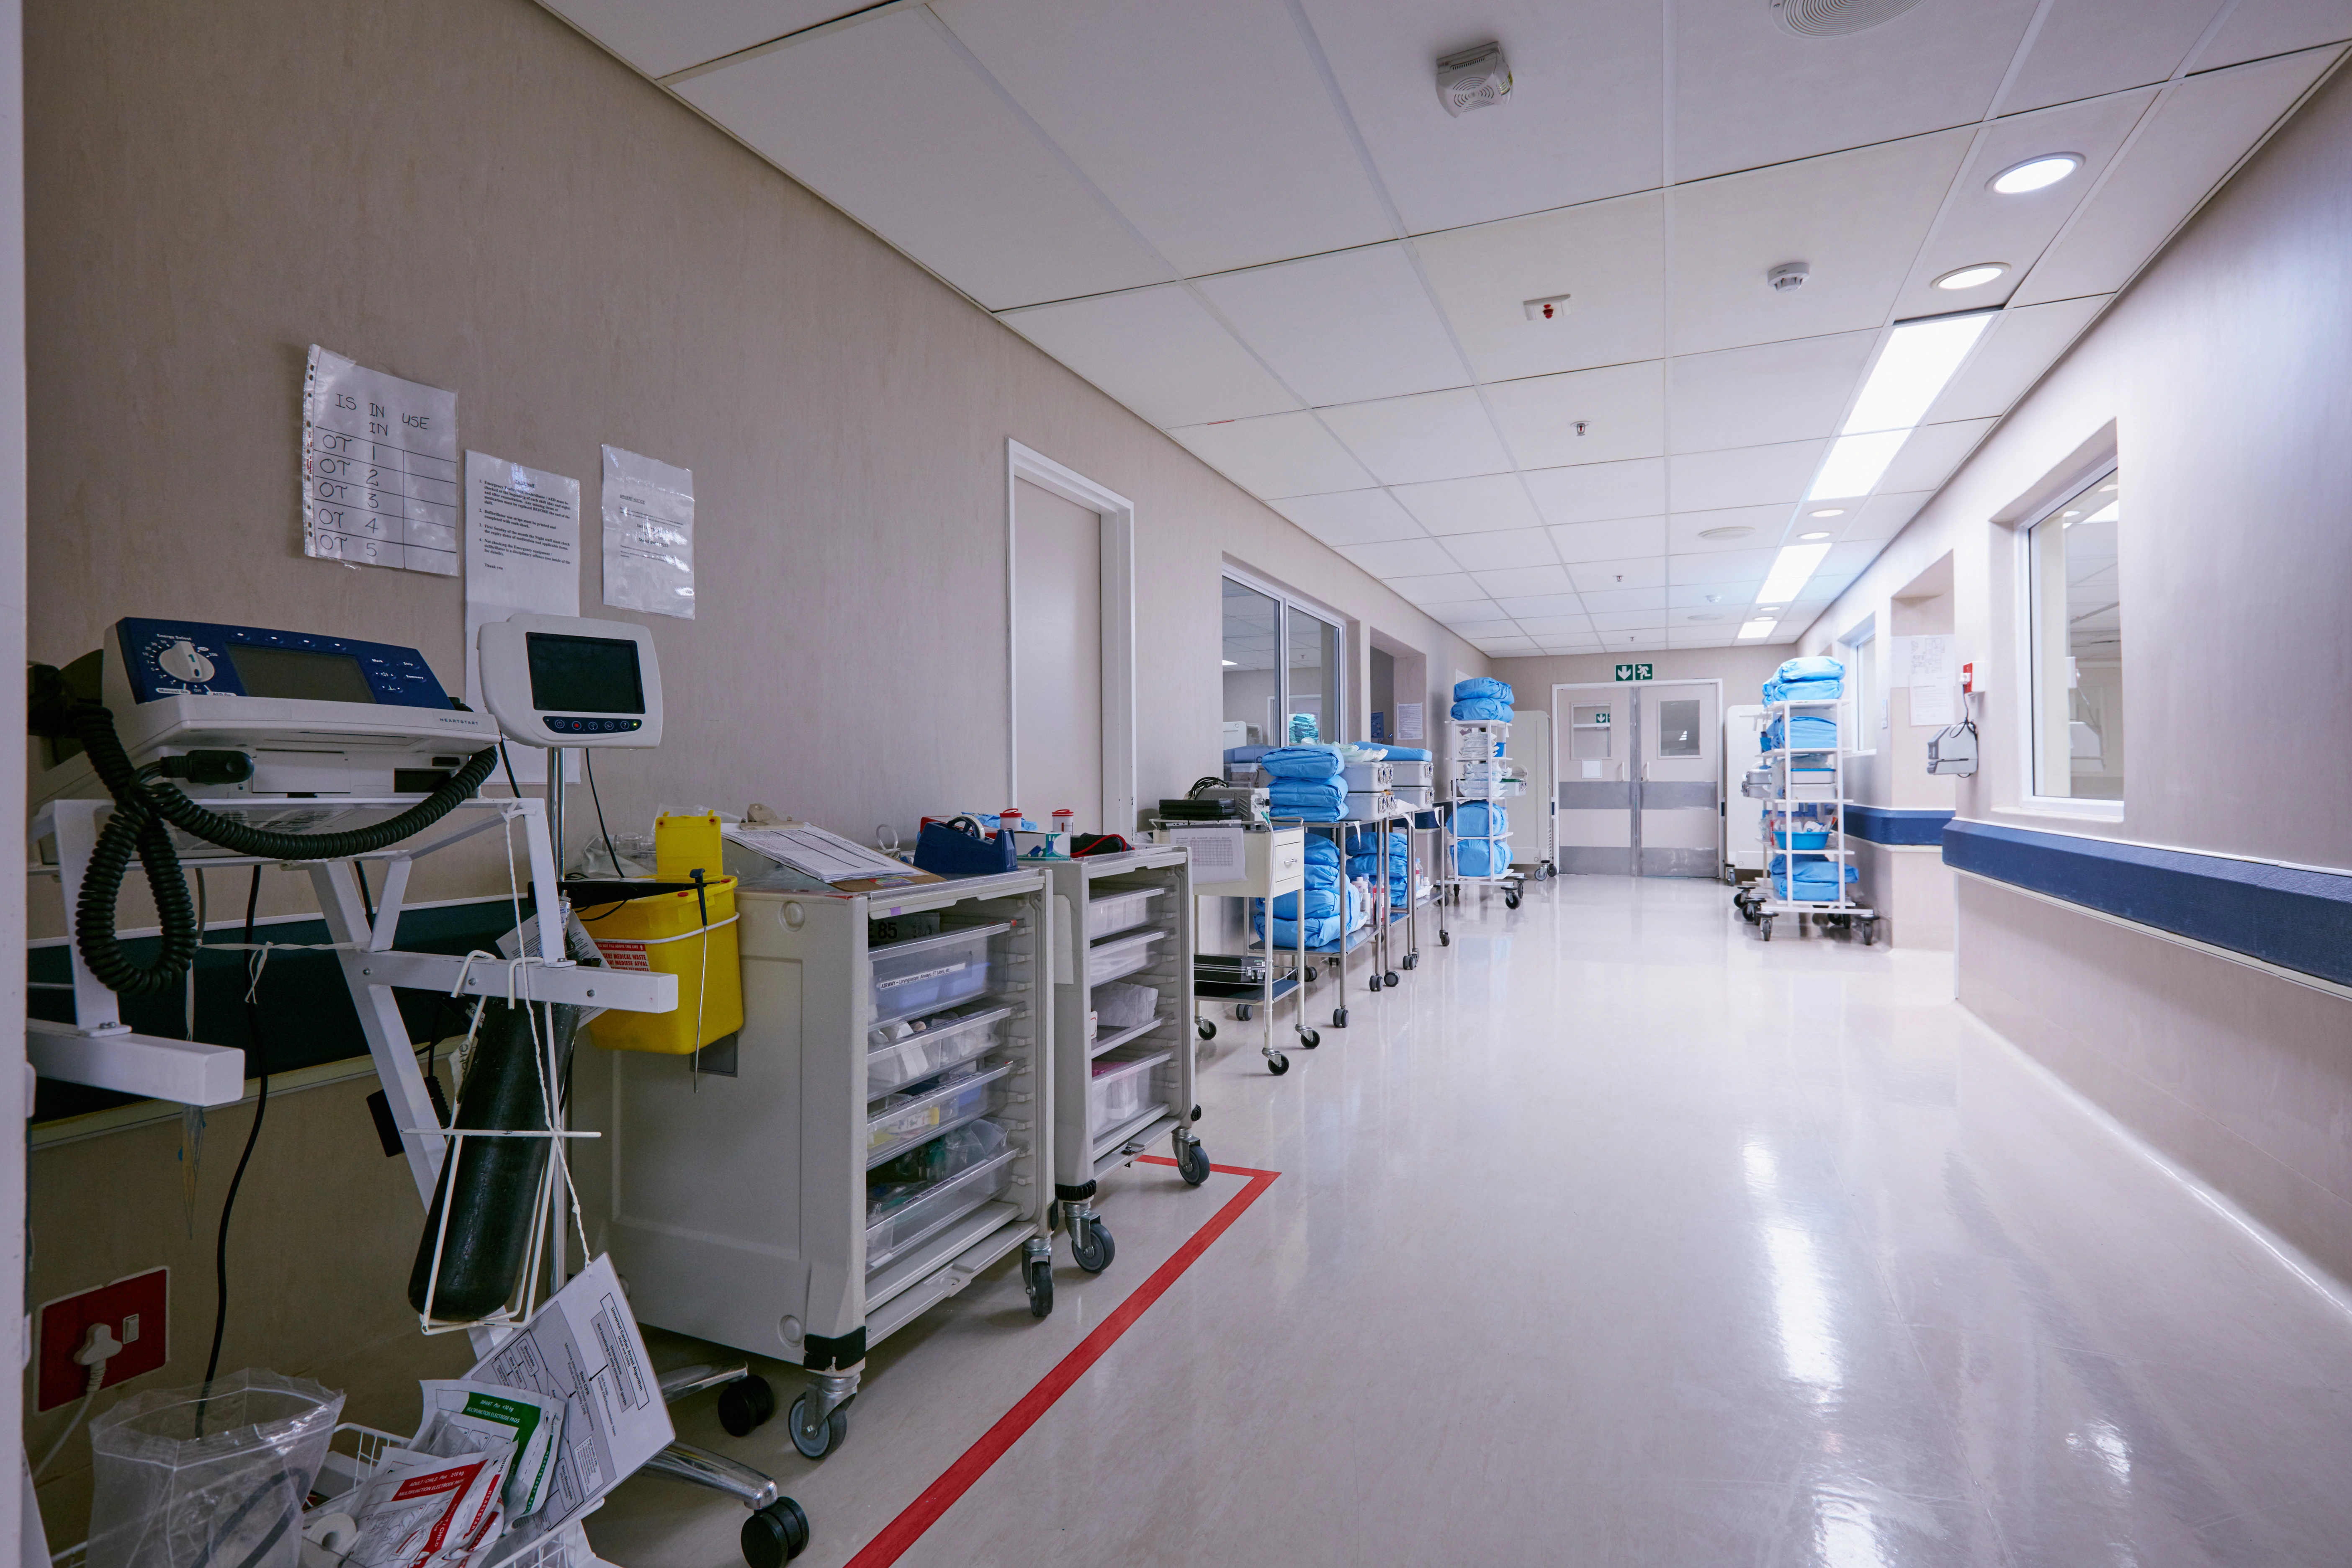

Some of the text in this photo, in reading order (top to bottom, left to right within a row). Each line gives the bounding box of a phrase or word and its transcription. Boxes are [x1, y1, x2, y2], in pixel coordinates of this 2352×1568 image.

[335, 394, 430, 430] IS IN USE
[369, 422, 388, 436] IN
[323, 434, 375, 460] OT 1
[320, 458, 350, 476] OT
[366, 469, 379, 487] 2
[319, 482, 379, 508] OT 3
[484, 480, 503, 489] Emergency
[525, 491, 545, 499] Defibrillator
[501, 495, 523, 503] resuscitation.
[509, 492, 526, 500] beginning
[319, 508, 378, 534] OT 4
[484, 510, 506, 518] Defibrillator
[320, 534, 377, 557] OT 5
[512, 549, 532, 558] disciplinary
[878, 922, 897, 939] 85
[899, 976, 919, 984] Laryngoscope,
[524, 1345, 535, 1367] Shockable
[610, 1307, 643, 1391] Universal Cardiac Arrest Algorithm
[610, 1344, 623, 1375] Unresponsive
[599, 1331, 610, 1352] breathing
[612, 1367, 623, 1392] occasional
[564, 1342, 573, 1361] Minimize
[571, 1360, 582, 1386] interruptions
[584, 1402, 594, 1431] compressions
[466, 1407, 491, 1416] MULTIFUNCTION
[490, 1412, 510, 1421] ELECTRODE
[532, 1451, 549, 1491] HEARTSTART
[561, 1464, 573, 1500] Non-Shockable
[398, 1481, 455, 1496] MULTIFUNCTION ELECTRODE
[434, 1527, 445, 1547] CHILD
